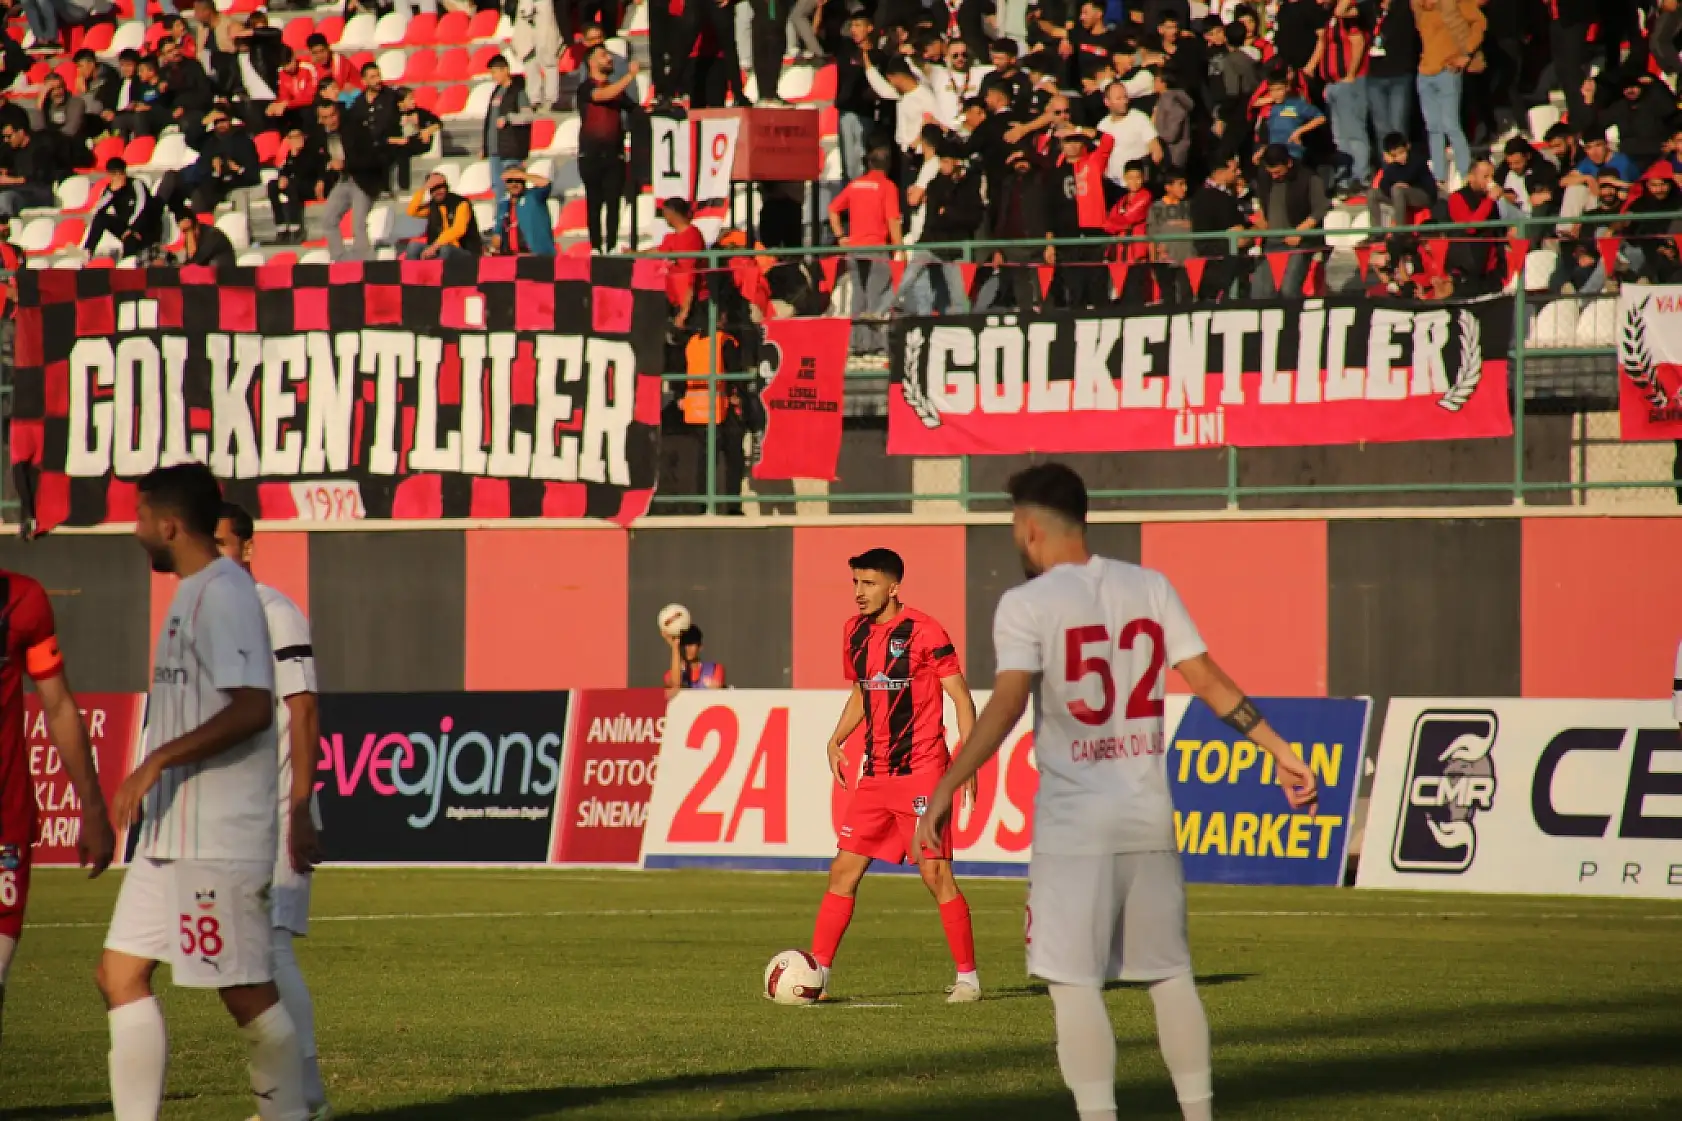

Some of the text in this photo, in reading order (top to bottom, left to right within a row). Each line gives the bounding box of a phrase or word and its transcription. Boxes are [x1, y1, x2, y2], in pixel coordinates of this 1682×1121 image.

[661, 129, 682, 179] 1
[926, 299, 1451, 416] GÖLKENTLİLER
[1065, 618, 1165, 726] 52
[666, 704, 790, 844] 2A
[1410, 776, 1495, 808] CMR
[1531, 727, 1682, 839] CE
[1579, 861, 1682, 885] PRE
[179, 914, 224, 956] 58
